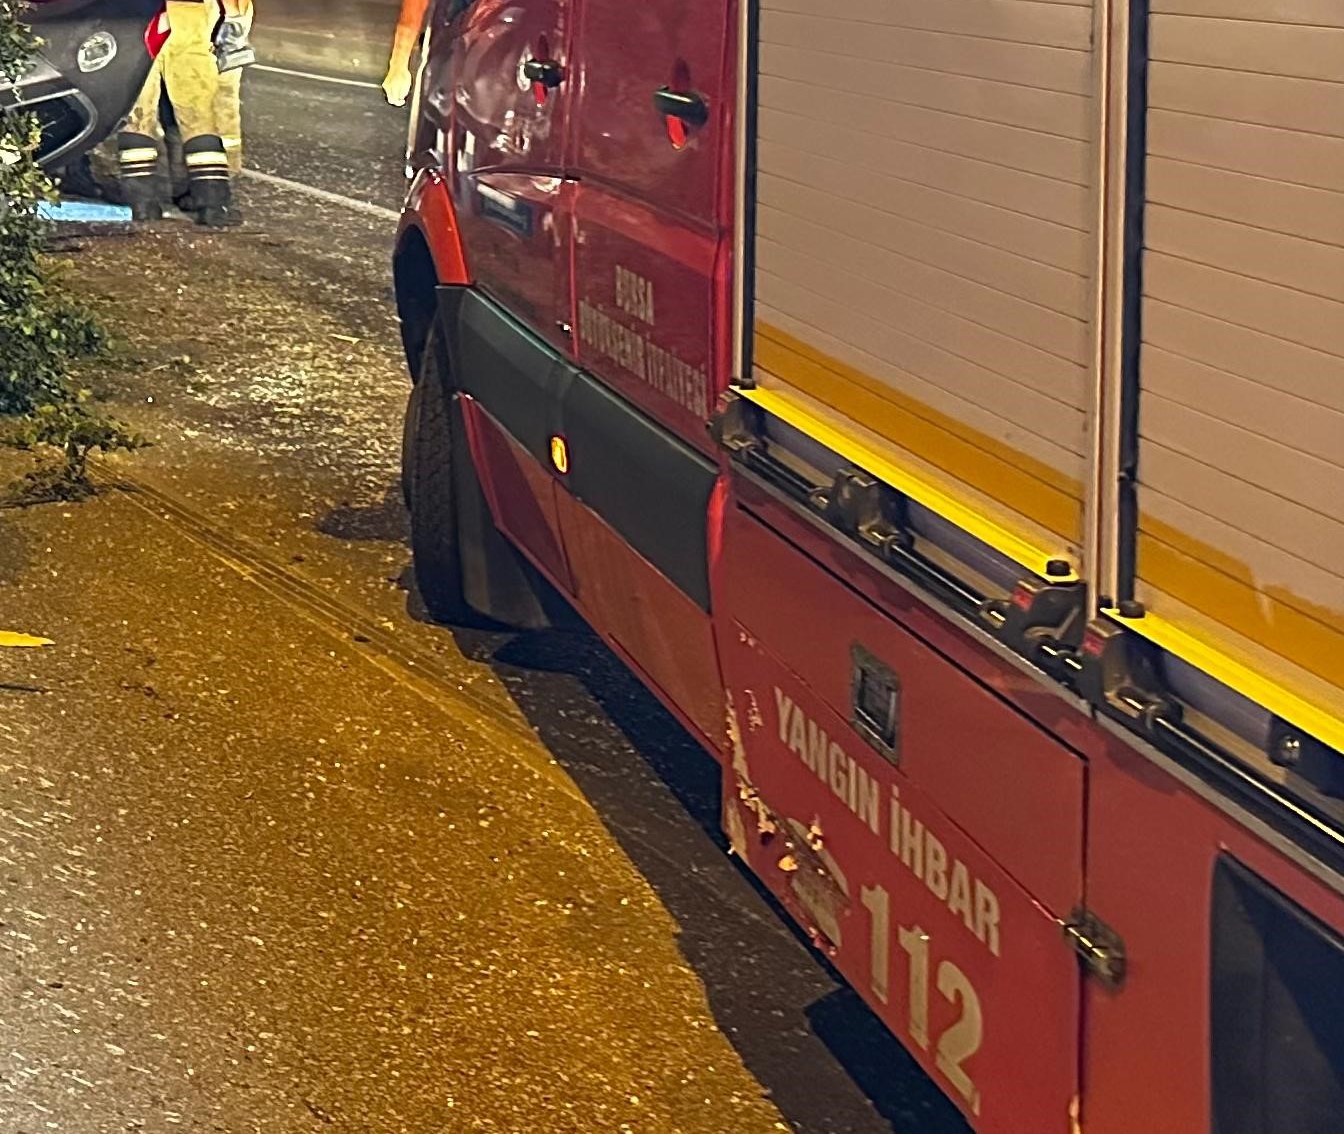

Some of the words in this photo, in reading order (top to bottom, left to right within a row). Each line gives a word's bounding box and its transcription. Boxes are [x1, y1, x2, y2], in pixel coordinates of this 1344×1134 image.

[614, 264, 654, 326] BURSA
[774, 685, 880, 836] YANGIN
[889, 785, 1001, 958] İHBAR
[859, 883, 983, 1117] 112
